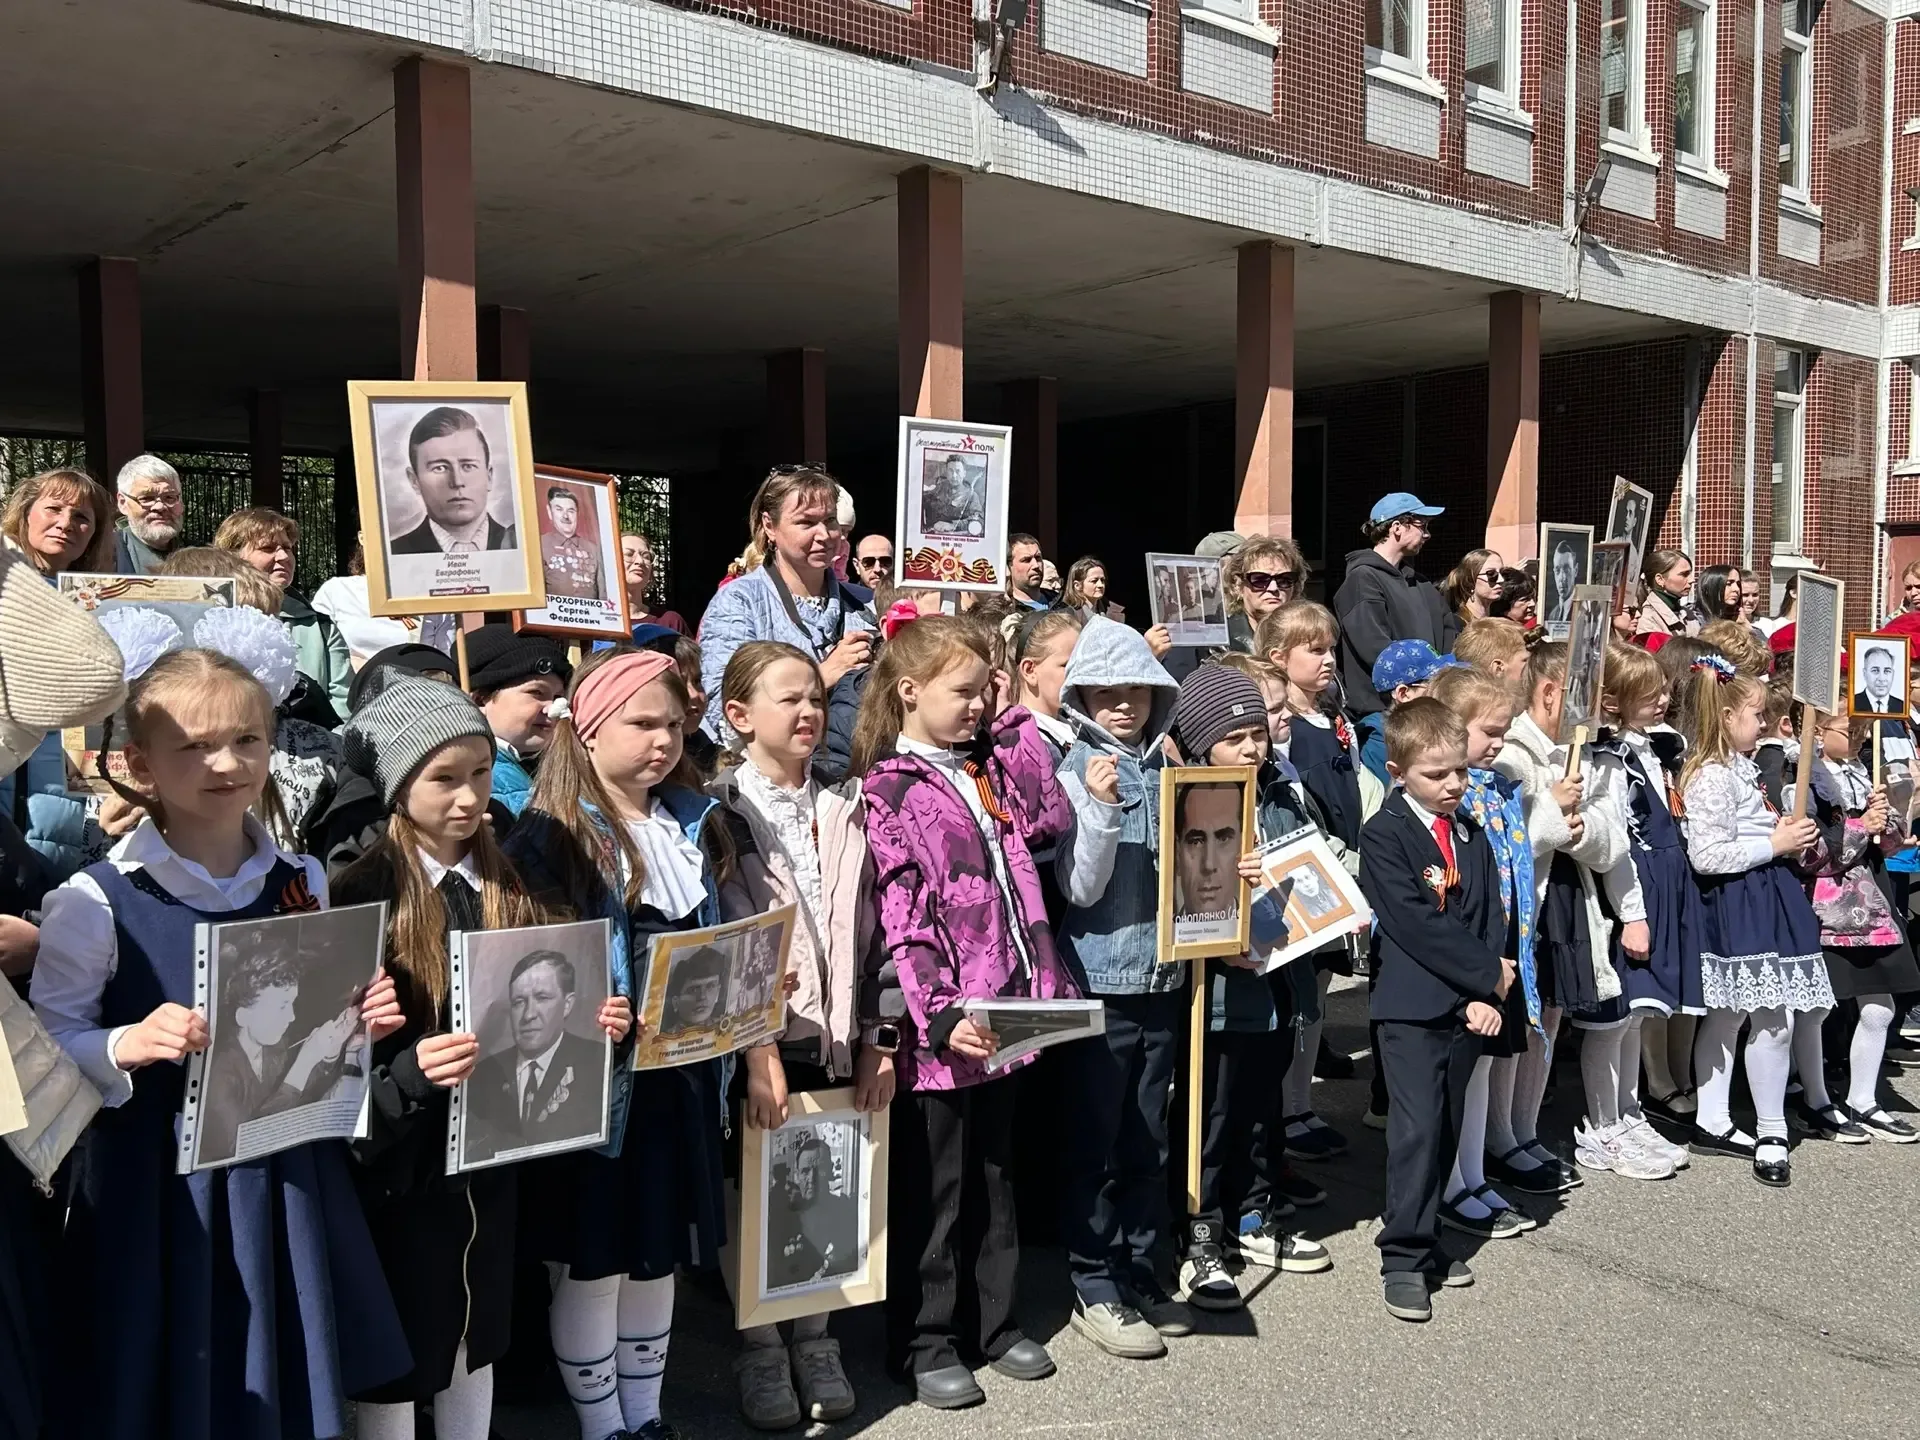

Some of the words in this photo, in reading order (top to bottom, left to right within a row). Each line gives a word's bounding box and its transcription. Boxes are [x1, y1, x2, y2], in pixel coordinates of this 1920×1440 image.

[435, 569, 480, 577] Евграфович
[558, 605, 590, 616] Сергей
[549, 612, 601, 626] Федосович
